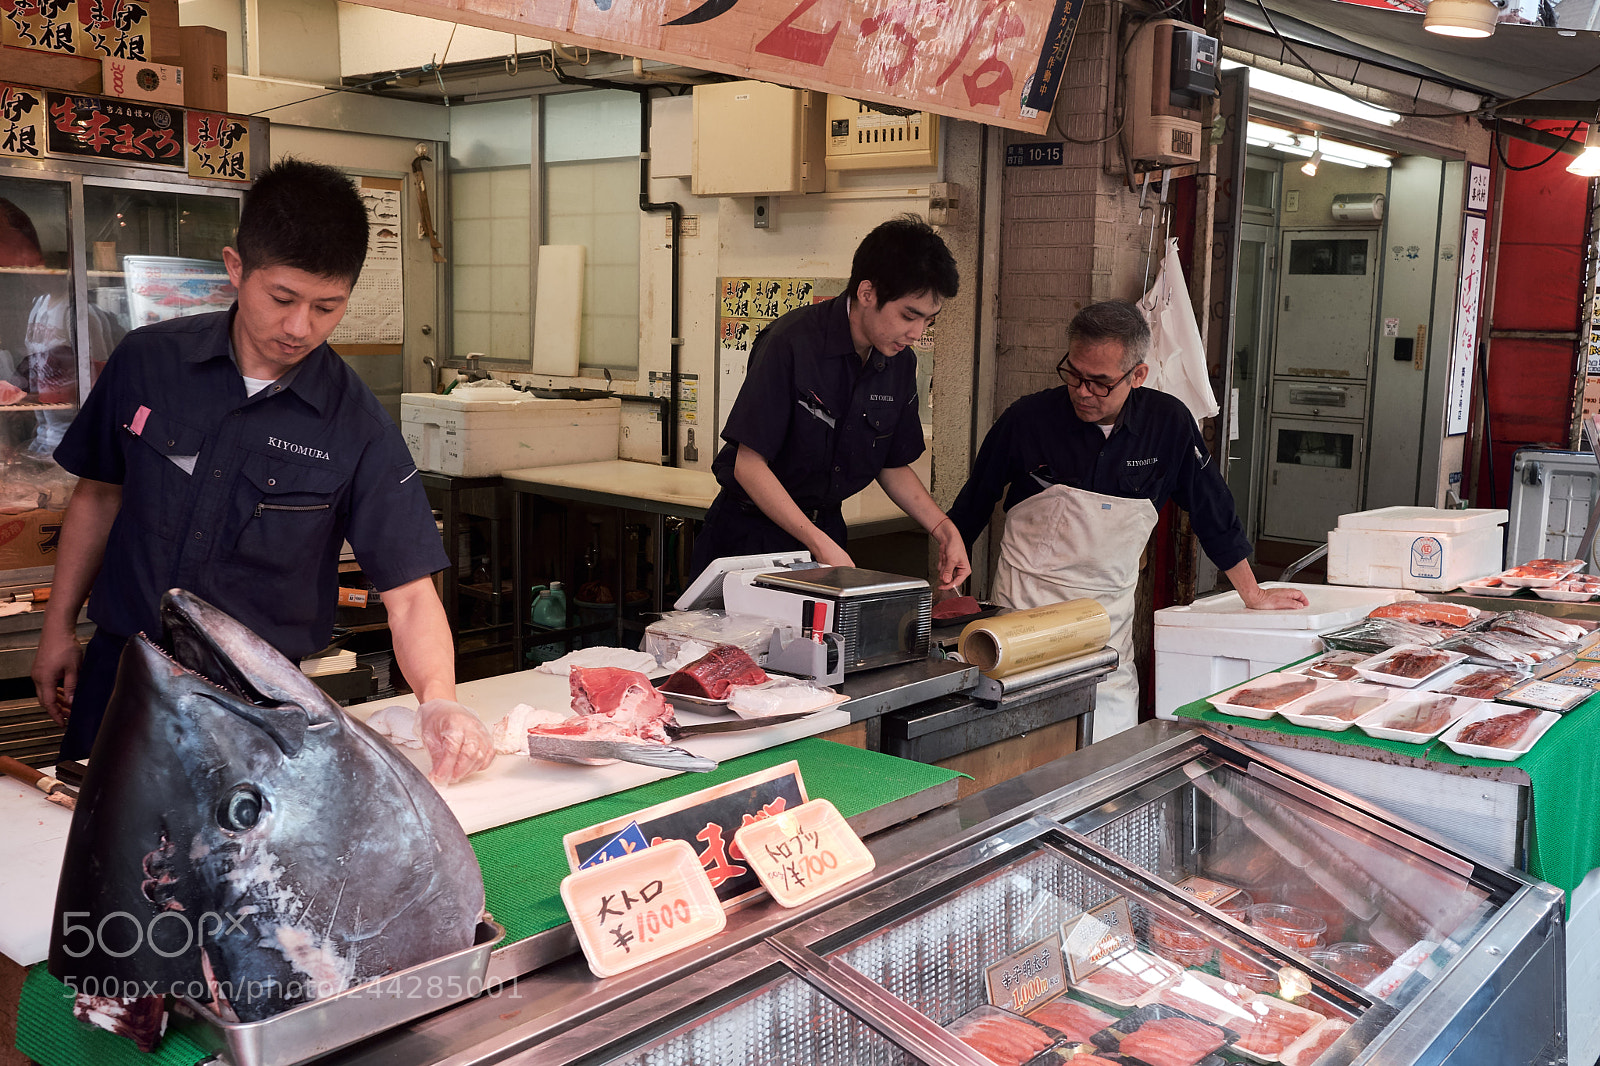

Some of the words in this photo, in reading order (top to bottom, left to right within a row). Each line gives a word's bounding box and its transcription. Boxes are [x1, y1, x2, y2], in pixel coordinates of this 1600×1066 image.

[50, 97, 181, 158] 生本まぐろ
[192, 118, 216, 176] まぐろ
[217, 119, 248, 179] 伊根
[1029, 147, 1060, 160] 10-15
[723, 280, 735, 316] まぐろ
[735, 280, 751, 317] 伊根
[752, 280, 764, 317] まぐろ
[764, 281, 781, 318] 伊根
[268, 436, 329, 460] KIYOMURA
[1002, 948, 1050, 989] 辛子明太子
